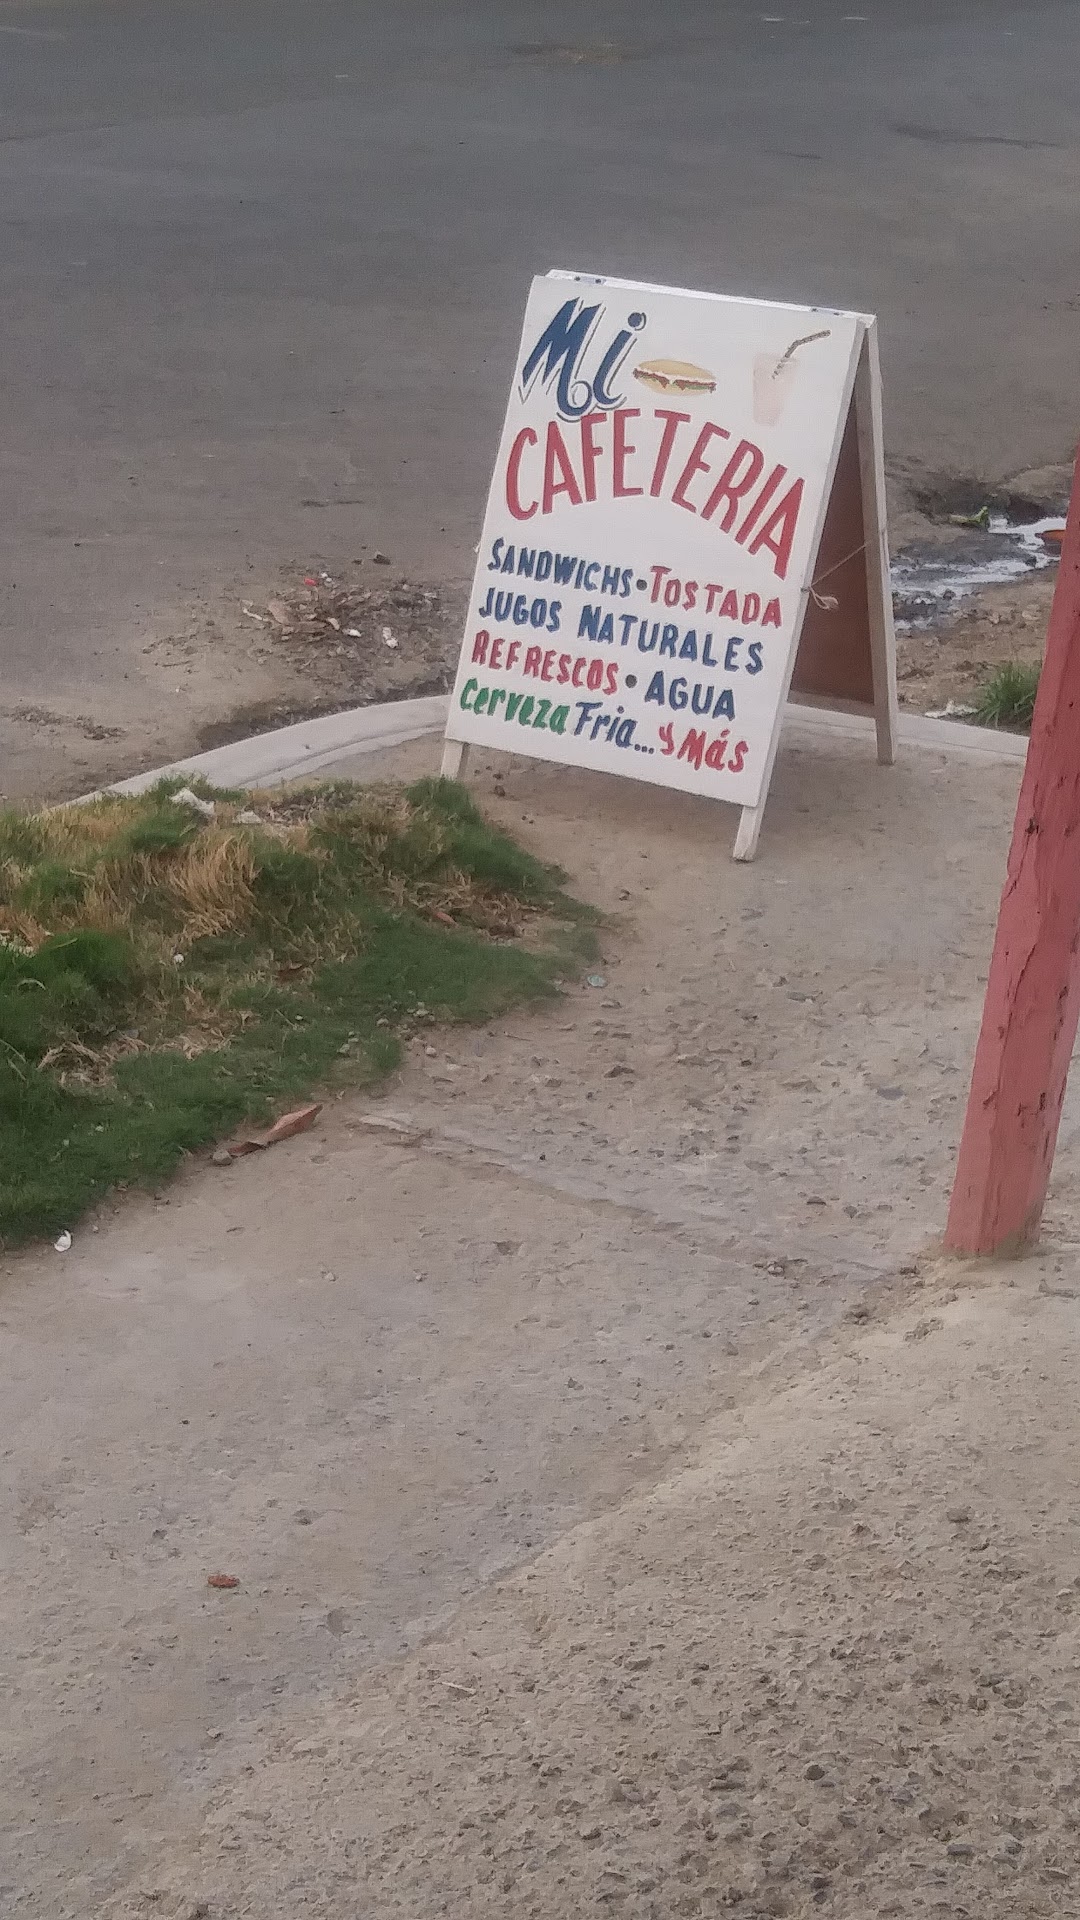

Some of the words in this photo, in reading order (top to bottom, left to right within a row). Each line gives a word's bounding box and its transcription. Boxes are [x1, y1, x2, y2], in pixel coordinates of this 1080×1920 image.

[519, 297, 646, 423] Mi
[506, 408, 805, 581] CAFETERIA
[487, 537, 634, 599] SANDWICHS
[650, 565, 783, 629] TOSTADA
[471, 629, 620, 695] REFRESCOS
[644, 670, 736, 721] AGUA
[478, 587, 563, 632] JUGOS
[577, 604, 764, 675] NATURALES
[459, 678, 572, 735] Cerveza
